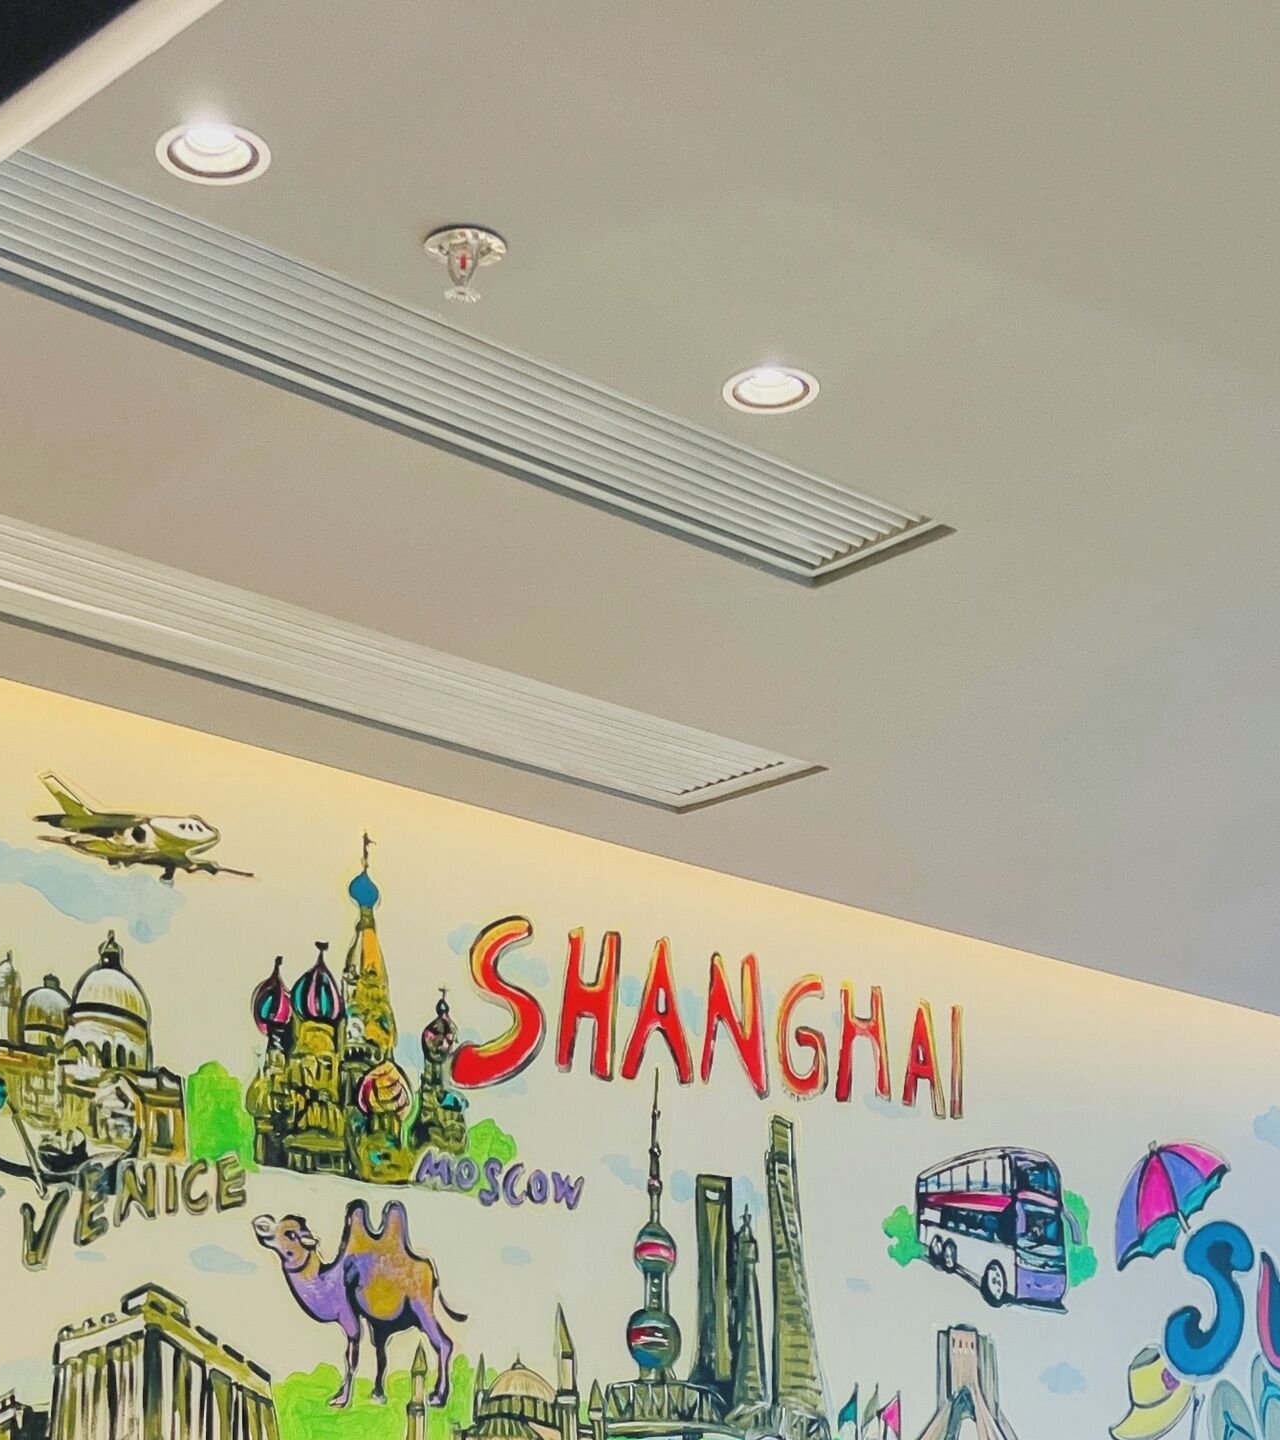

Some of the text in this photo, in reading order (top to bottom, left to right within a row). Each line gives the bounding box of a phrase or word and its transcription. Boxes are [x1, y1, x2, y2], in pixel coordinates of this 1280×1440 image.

[450, 915, 963, 1120] SHANGHAI
[19, 1154, 250, 1270] VENICE
[416, 1148, 586, 1211] MOSCOW
